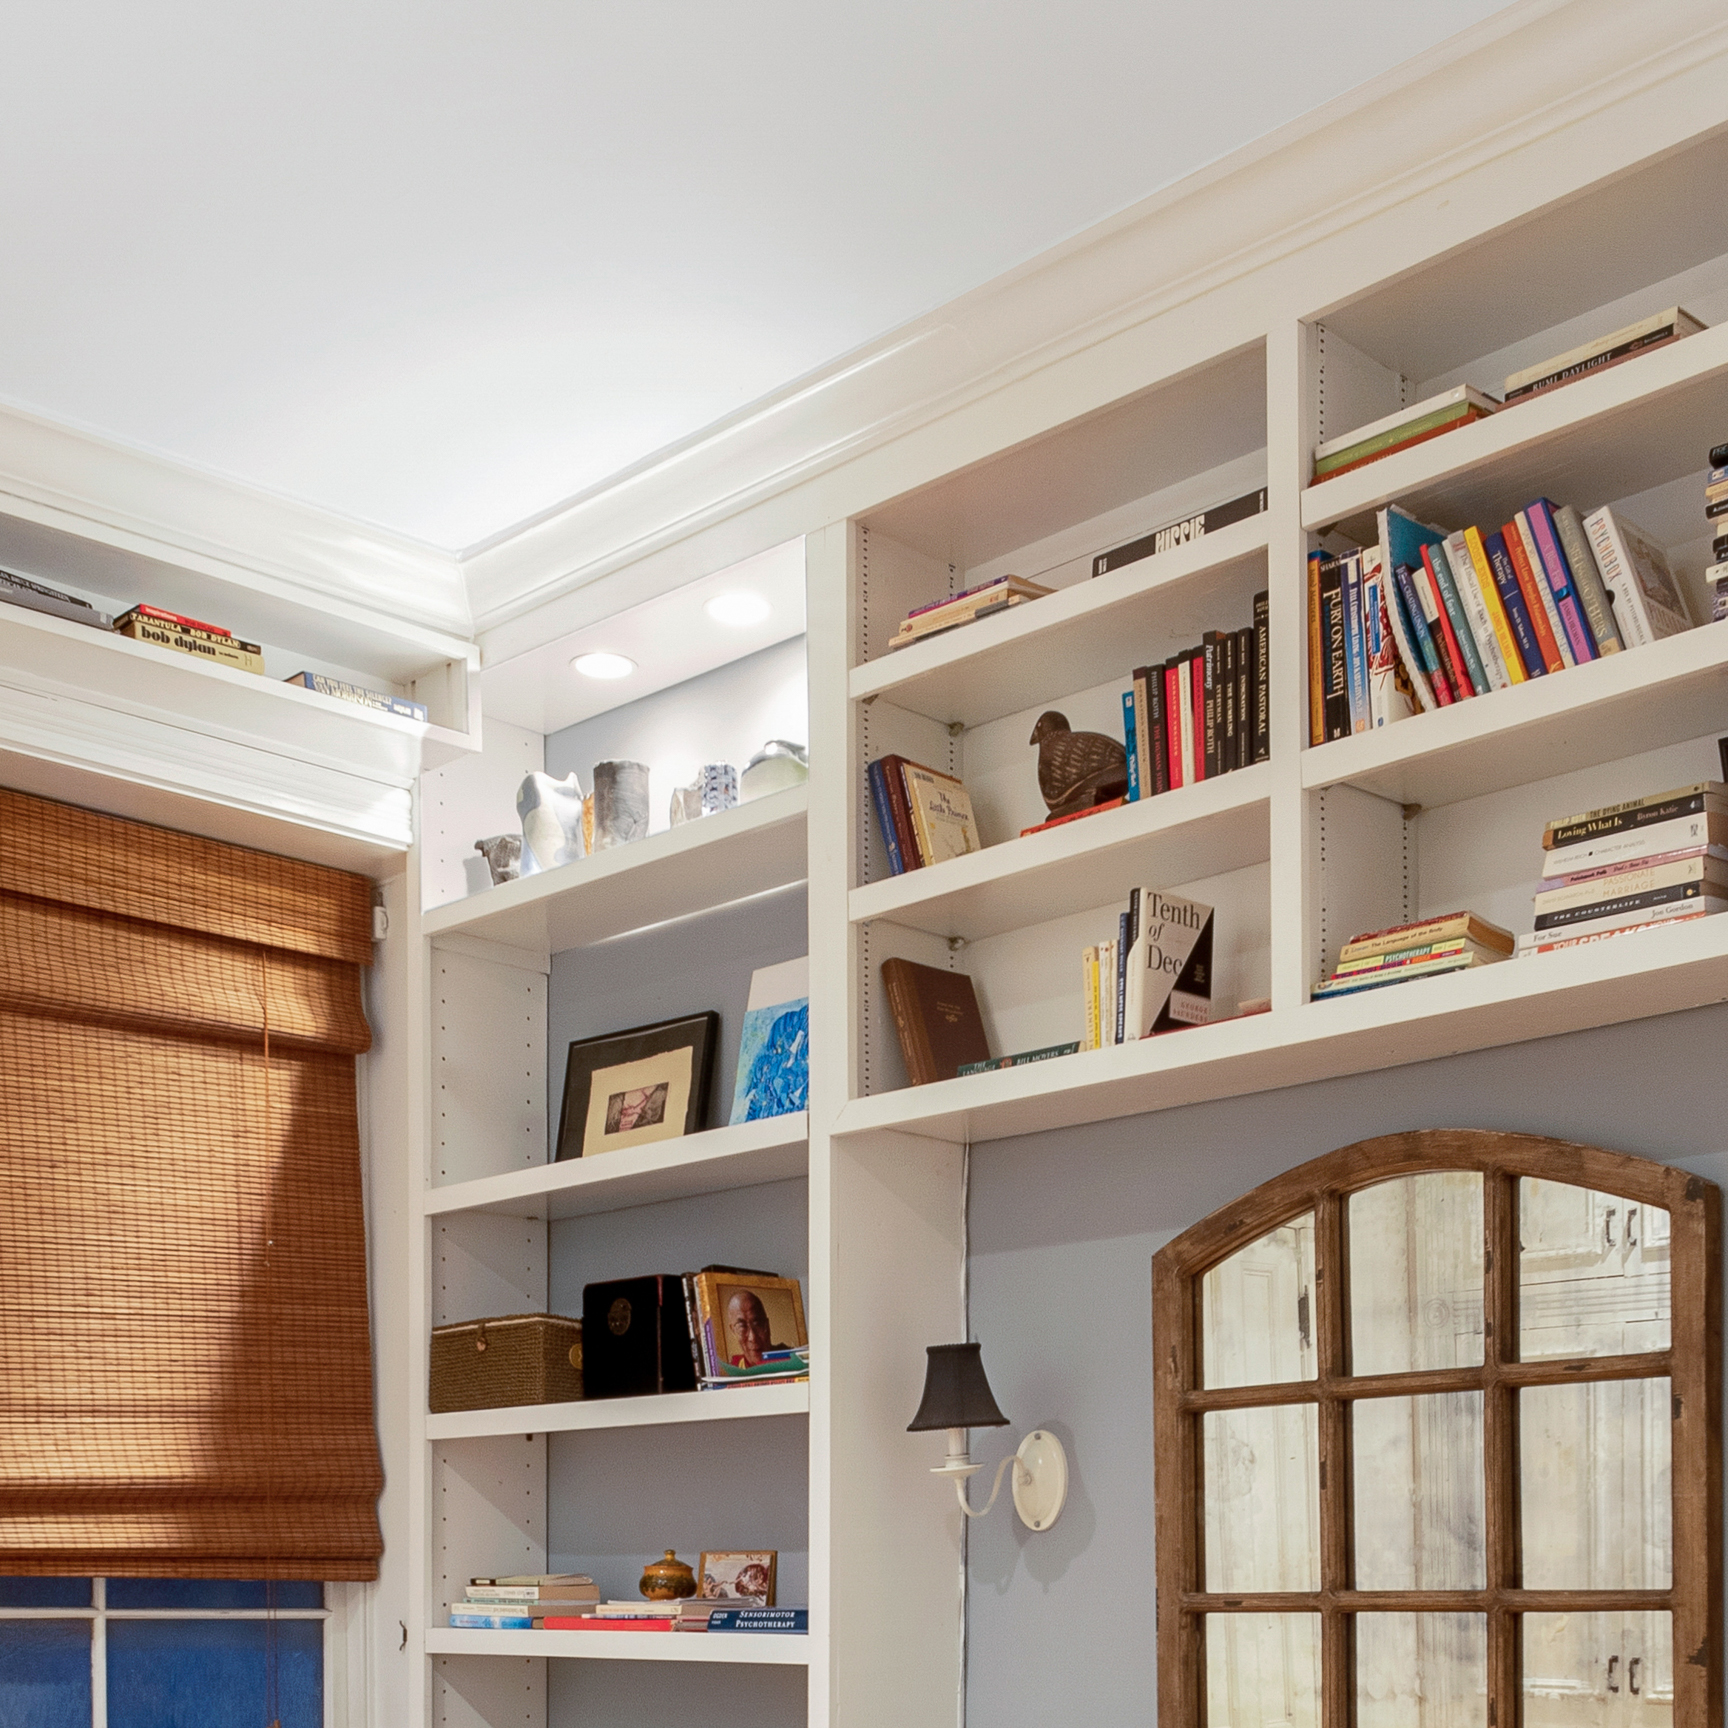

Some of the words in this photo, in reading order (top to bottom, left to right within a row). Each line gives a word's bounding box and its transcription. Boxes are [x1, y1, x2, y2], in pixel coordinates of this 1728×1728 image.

[1532, 374, 1560, 392] RUMI
[1562, 353, 1612, 380] DAYLIGHT
[1155, 514, 1206, 555] HIPPIE
[1432, 557, 1441, 569] the
[1590, 517, 1623, 583] PSYCHOBOX
[1437, 569, 1448, 585] end
[1492, 551, 1506, 585] Therapy
[1324, 586, 1342, 624] FURY
[1443, 586, 1451, 598] of
[1446, 597, 1456, 616] fear
[130, 613, 182, 633] TARANTULA
[189, 628, 210, 640] BOB
[210, 632, 239, 648] DYLAN
[141, 625, 170, 645] bob
[175, 636, 216, 656] dylan
[1331, 625, 1342, 649] ON
[1259, 625, 1267, 681] AMERICAN
[1205, 644, 1214, 690] Patrimony
[1326, 649, 1345, 699] EARTH
[1206, 700, 1214, 728] PHILIP
[1258, 684, 1267, 736] PASTORAL
[1154, 740, 1163, 770] HUMAN
[1590, 809, 1600, 818] THE
[1602, 805, 1621, 815] DYING
[1622, 799, 1644, 812] ANIMAL
[1558, 824, 1586, 840] Loving
[1588, 819, 1612, 832] What
[1614, 816, 1622, 827] Is
[1603, 869, 1655, 886] PASSIONATE
[1603, 880, 1655, 898] MARRIAGE
[1147, 891, 1200, 930] Tenth
[1651, 908, 1664, 919] Jon
[1665, 902, 1694, 915] Gordon
[1148, 924, 1165, 942] of
[1371, 940, 1382, 948] The
[1382, 934, 1410, 946] Language
[1429, 925, 1443, 935] Body
[1533, 933, 1547, 942] For
[1147, 944, 1183, 976] Dec
[1385, 946, 1432, 963] PSYCHOTHERAPY
[736, 1620, 795, 1628] PSYCHOTHERAPY
